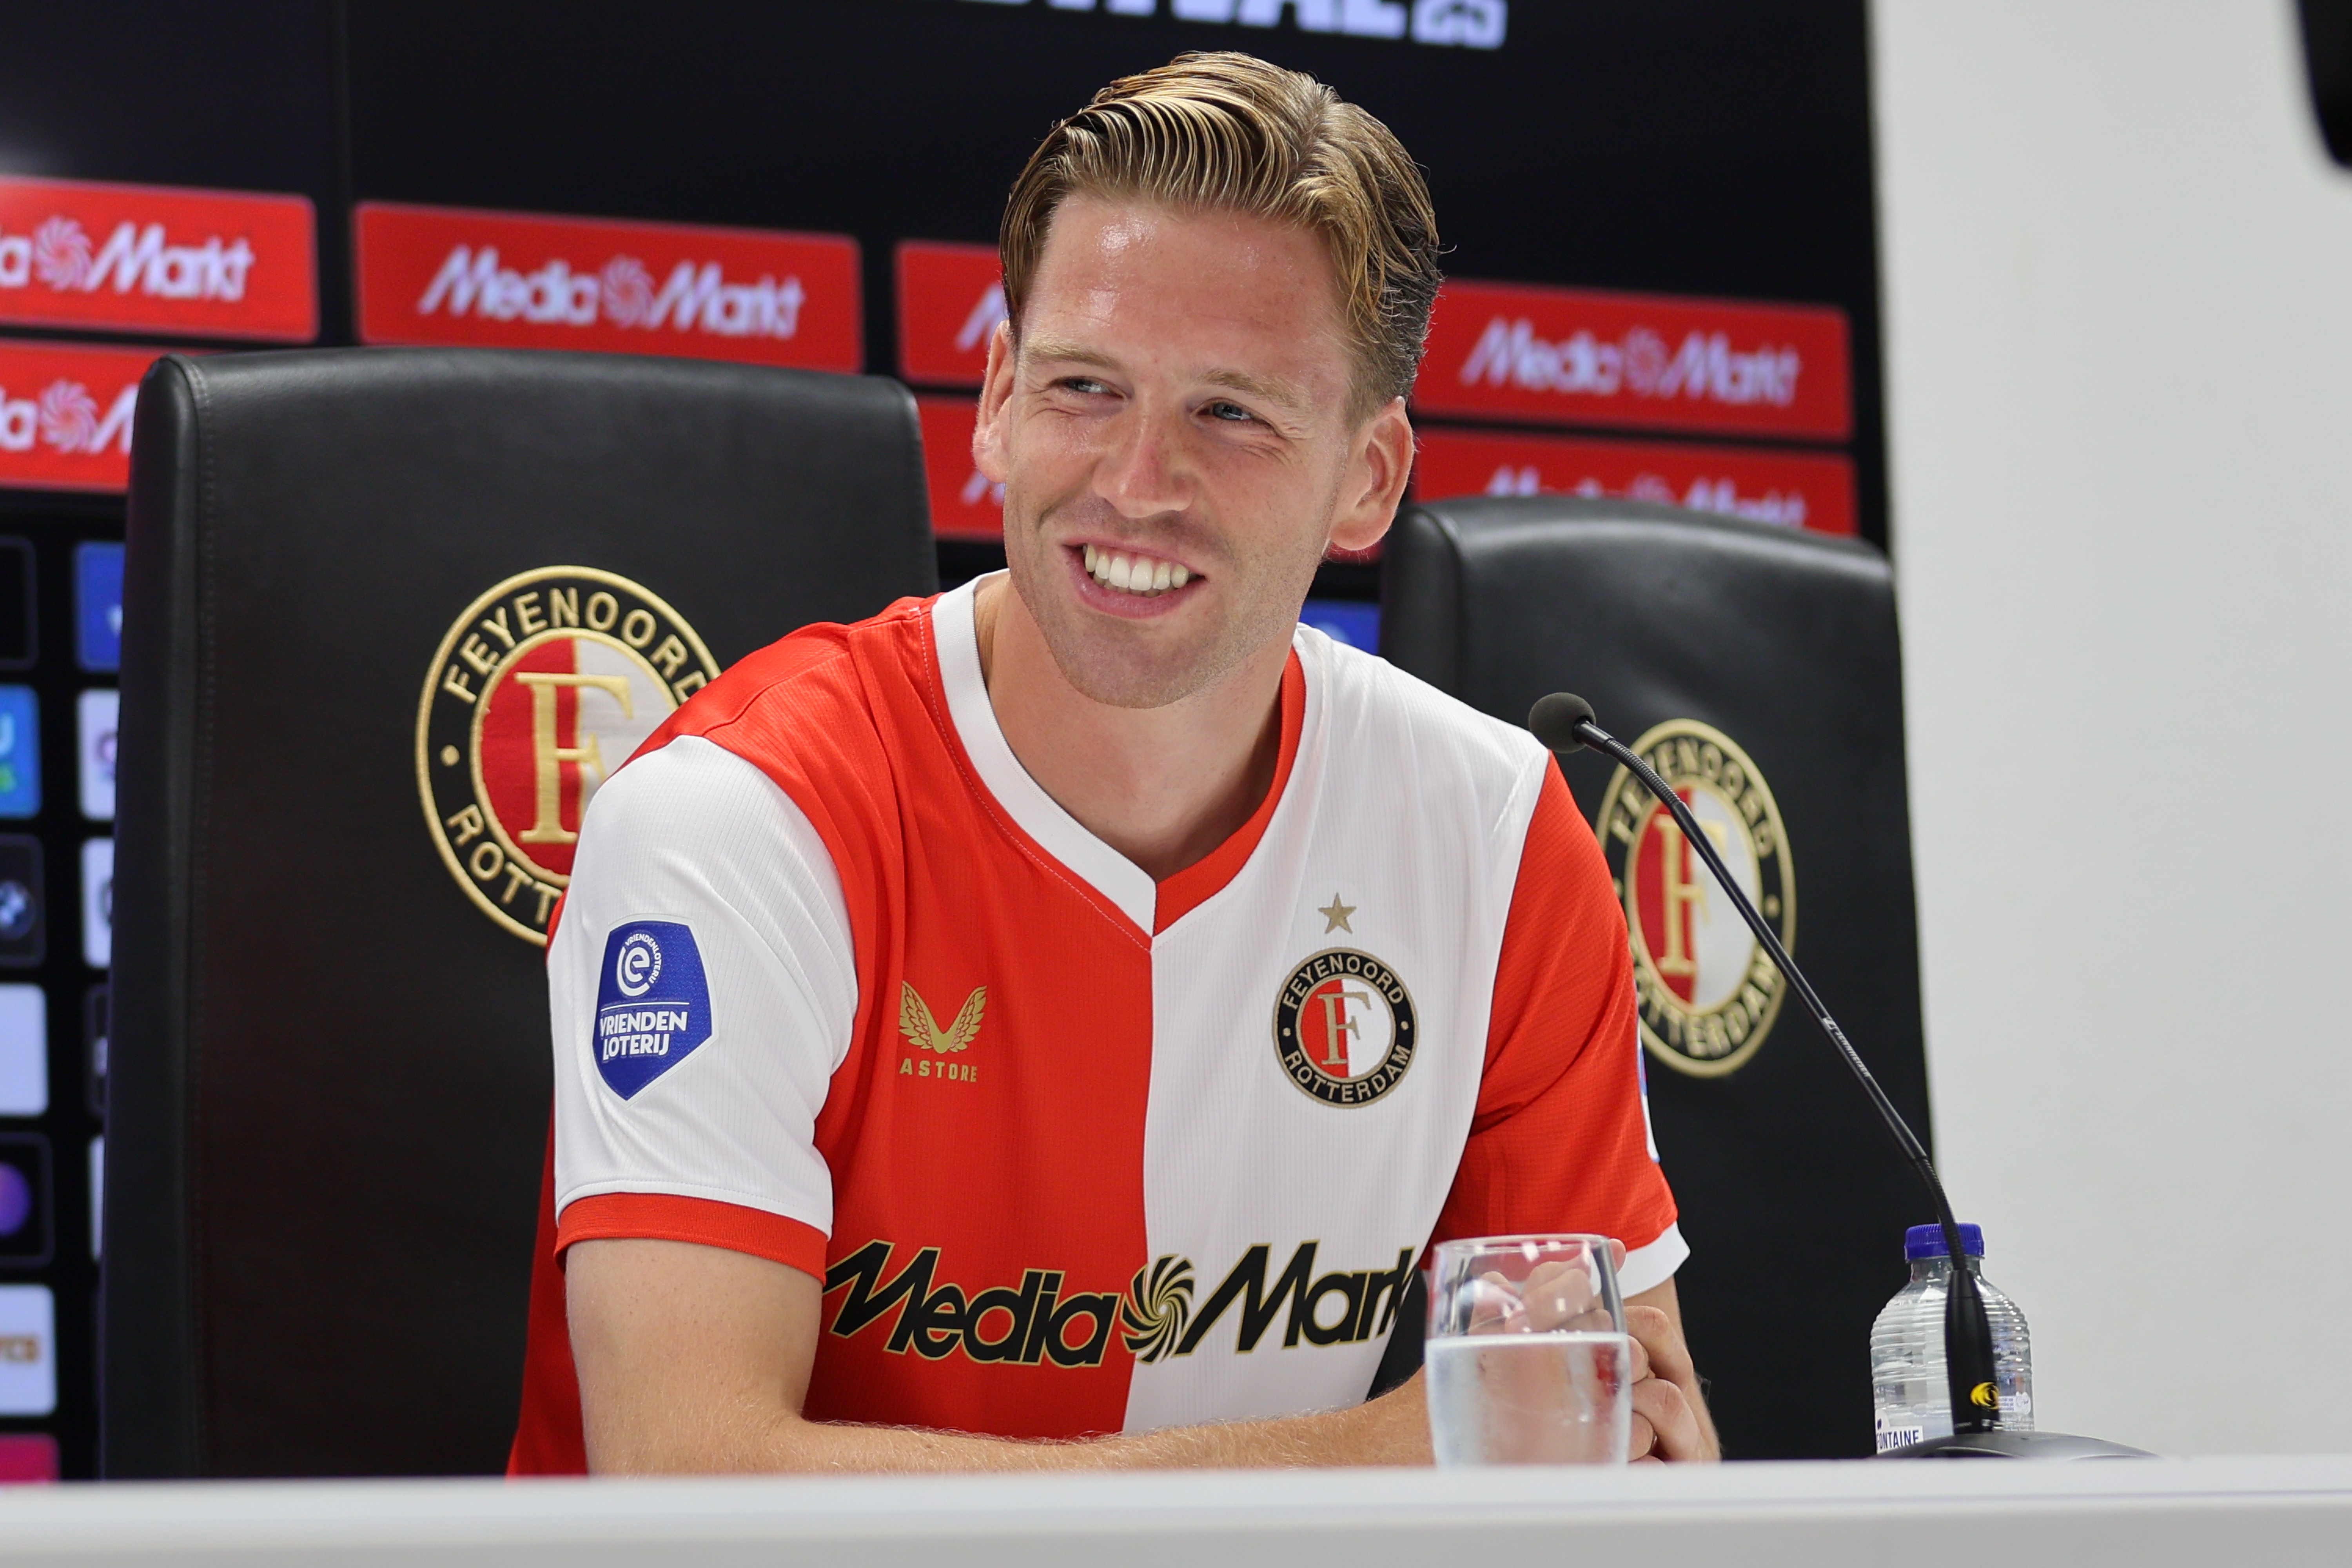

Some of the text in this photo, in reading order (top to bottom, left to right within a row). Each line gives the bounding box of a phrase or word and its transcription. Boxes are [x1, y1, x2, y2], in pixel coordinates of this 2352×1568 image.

[514, 671, 633, 843] F
[1654, 812, 1726, 975] F
[624, 933, 662, 985] VRIENDENLOTERIJ
[1283, 953, 1405, 1010] FEYENOORD
[599, 1011, 688, 1037] VRIENDEN
[602, 1033, 670, 1061] LOTERIJ
[1317, 992, 1372, 1065] F
[899, 1058, 978, 1083] ASTORE
[1284, 1044, 1411, 1103] ROTTERDAM
[822, 1238, 1417, 1369] Media Mark
